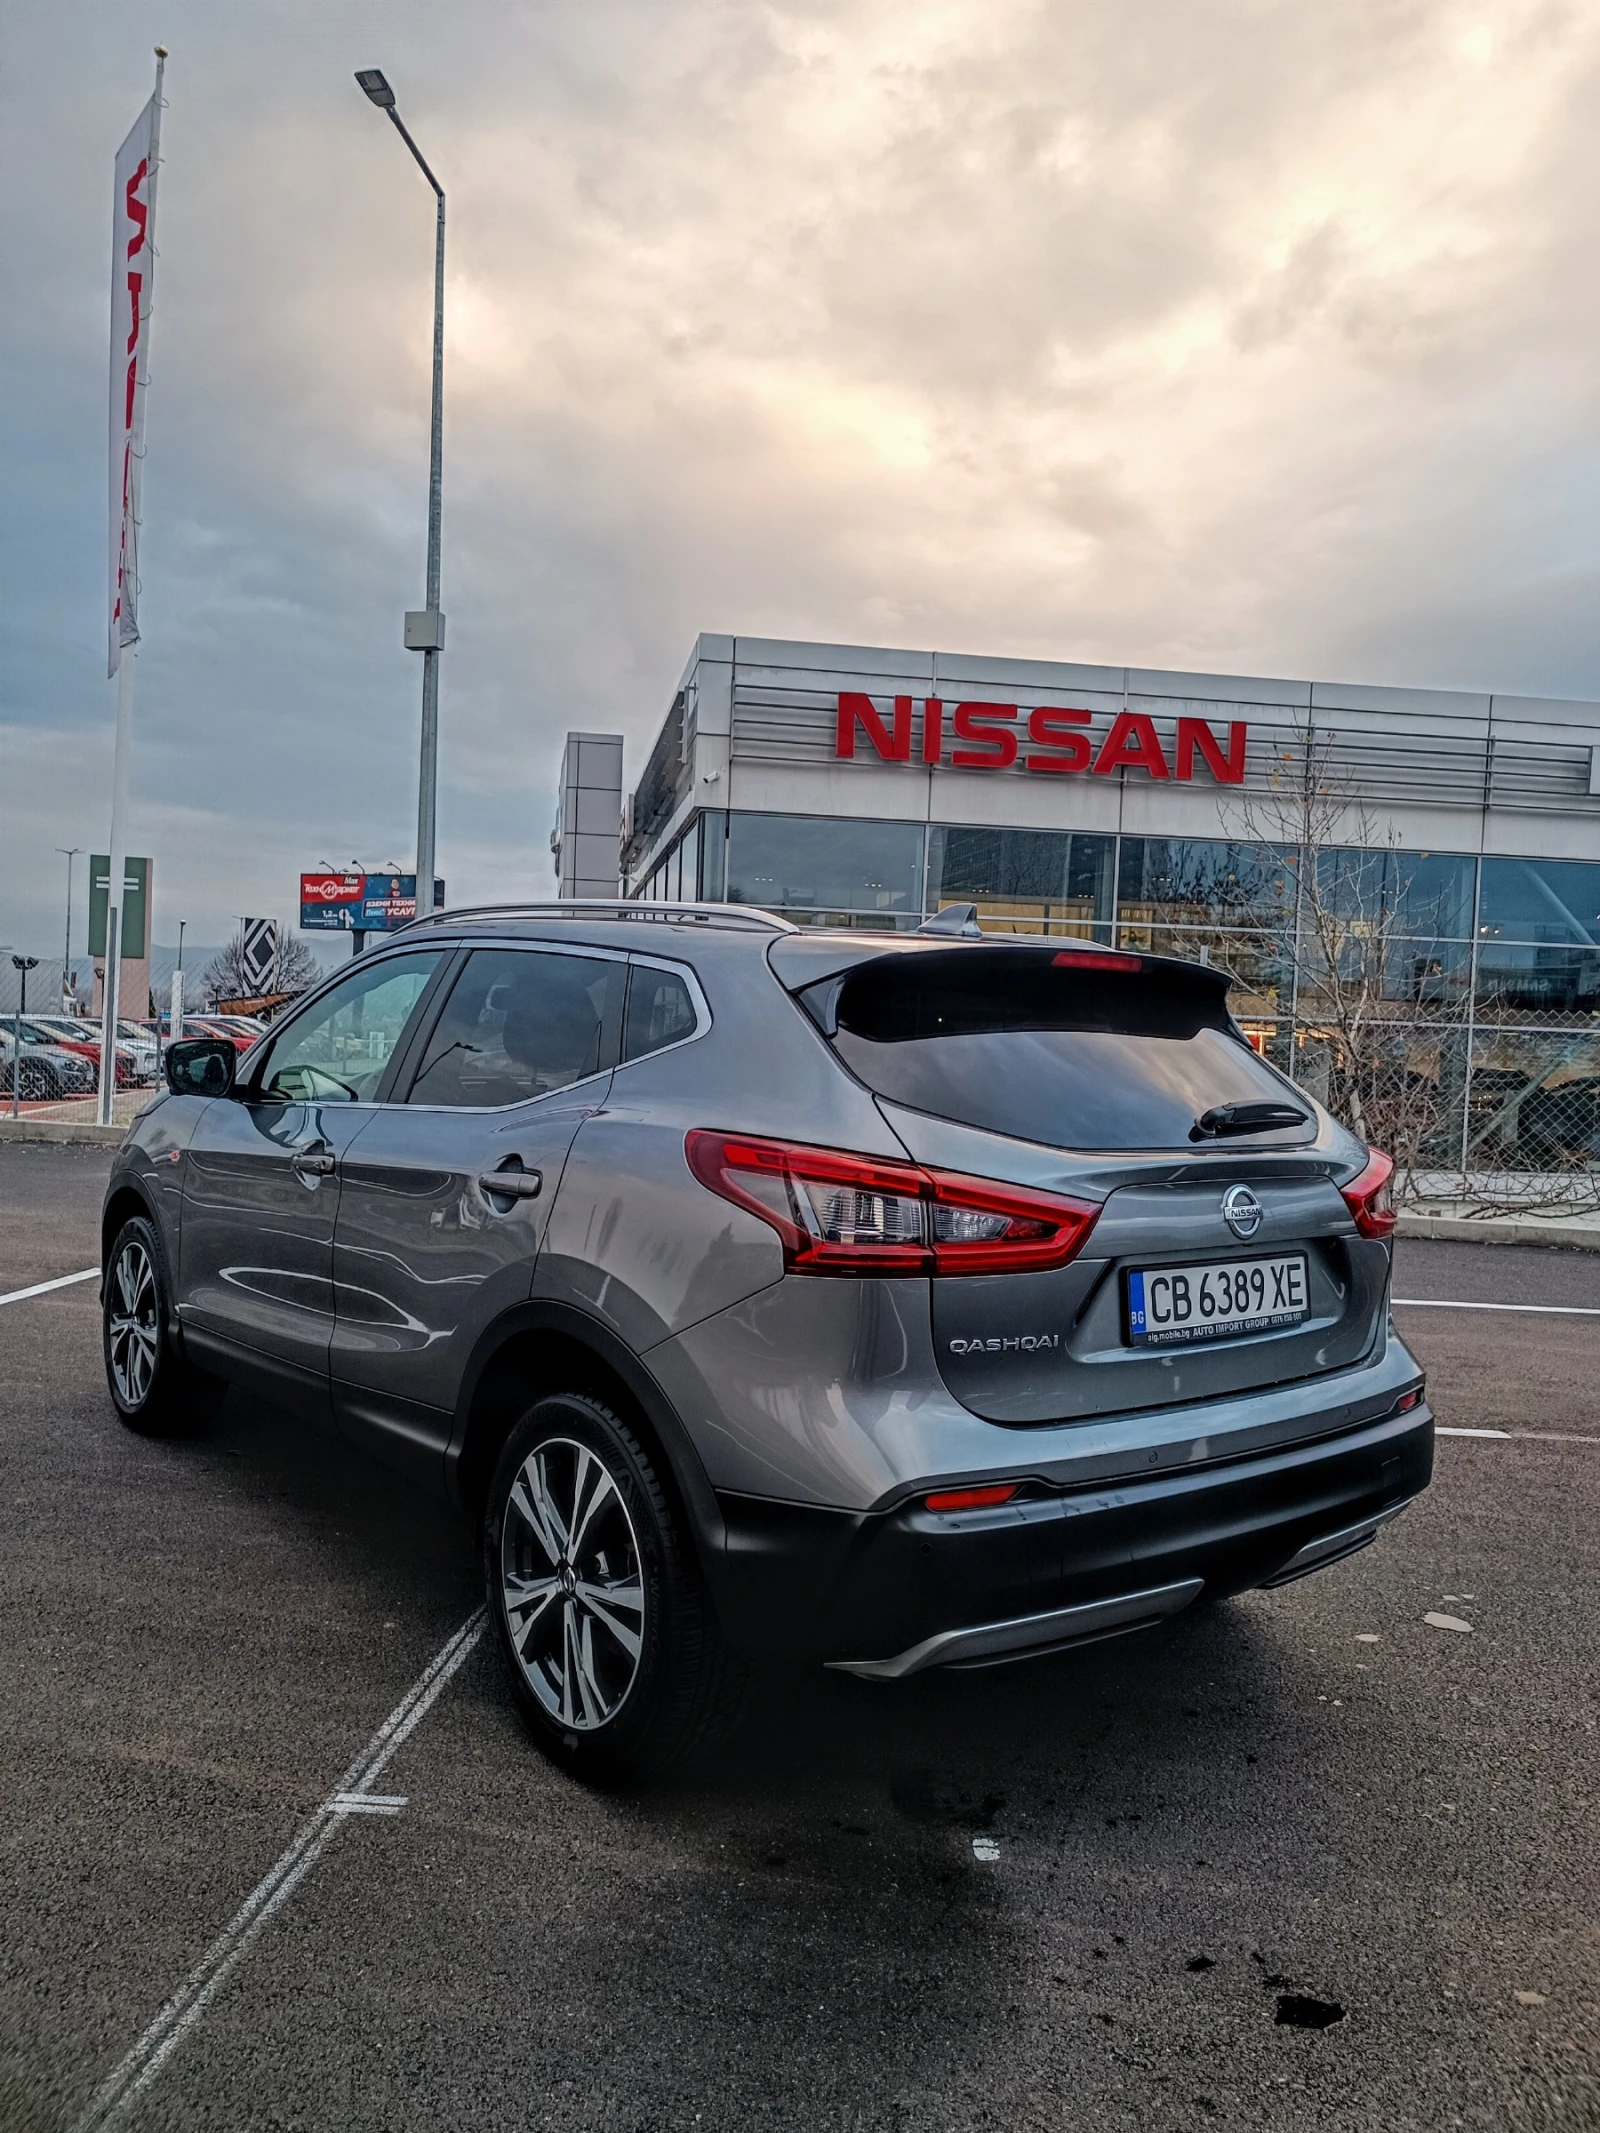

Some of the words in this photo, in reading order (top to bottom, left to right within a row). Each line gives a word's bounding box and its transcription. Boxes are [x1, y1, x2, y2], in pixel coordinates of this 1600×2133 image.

[836, 691, 1247, 784] NISSAN
[1231, 1207, 1261, 1218] NISSAN
[1151, 1275, 1192, 1324] CB
[1200, 1268, 1265, 1318] 6389
[1270, 1263, 1304, 1310] XE
[1131, 1310, 1144, 1326] BG
[1193, 1325, 1214, 1337] AUTO
[1215, 1321, 1244, 1334] IMPORT
[1245, 1317, 1269, 1329] GROUP
[950, 1334, 1059, 1356] QASHQAI
